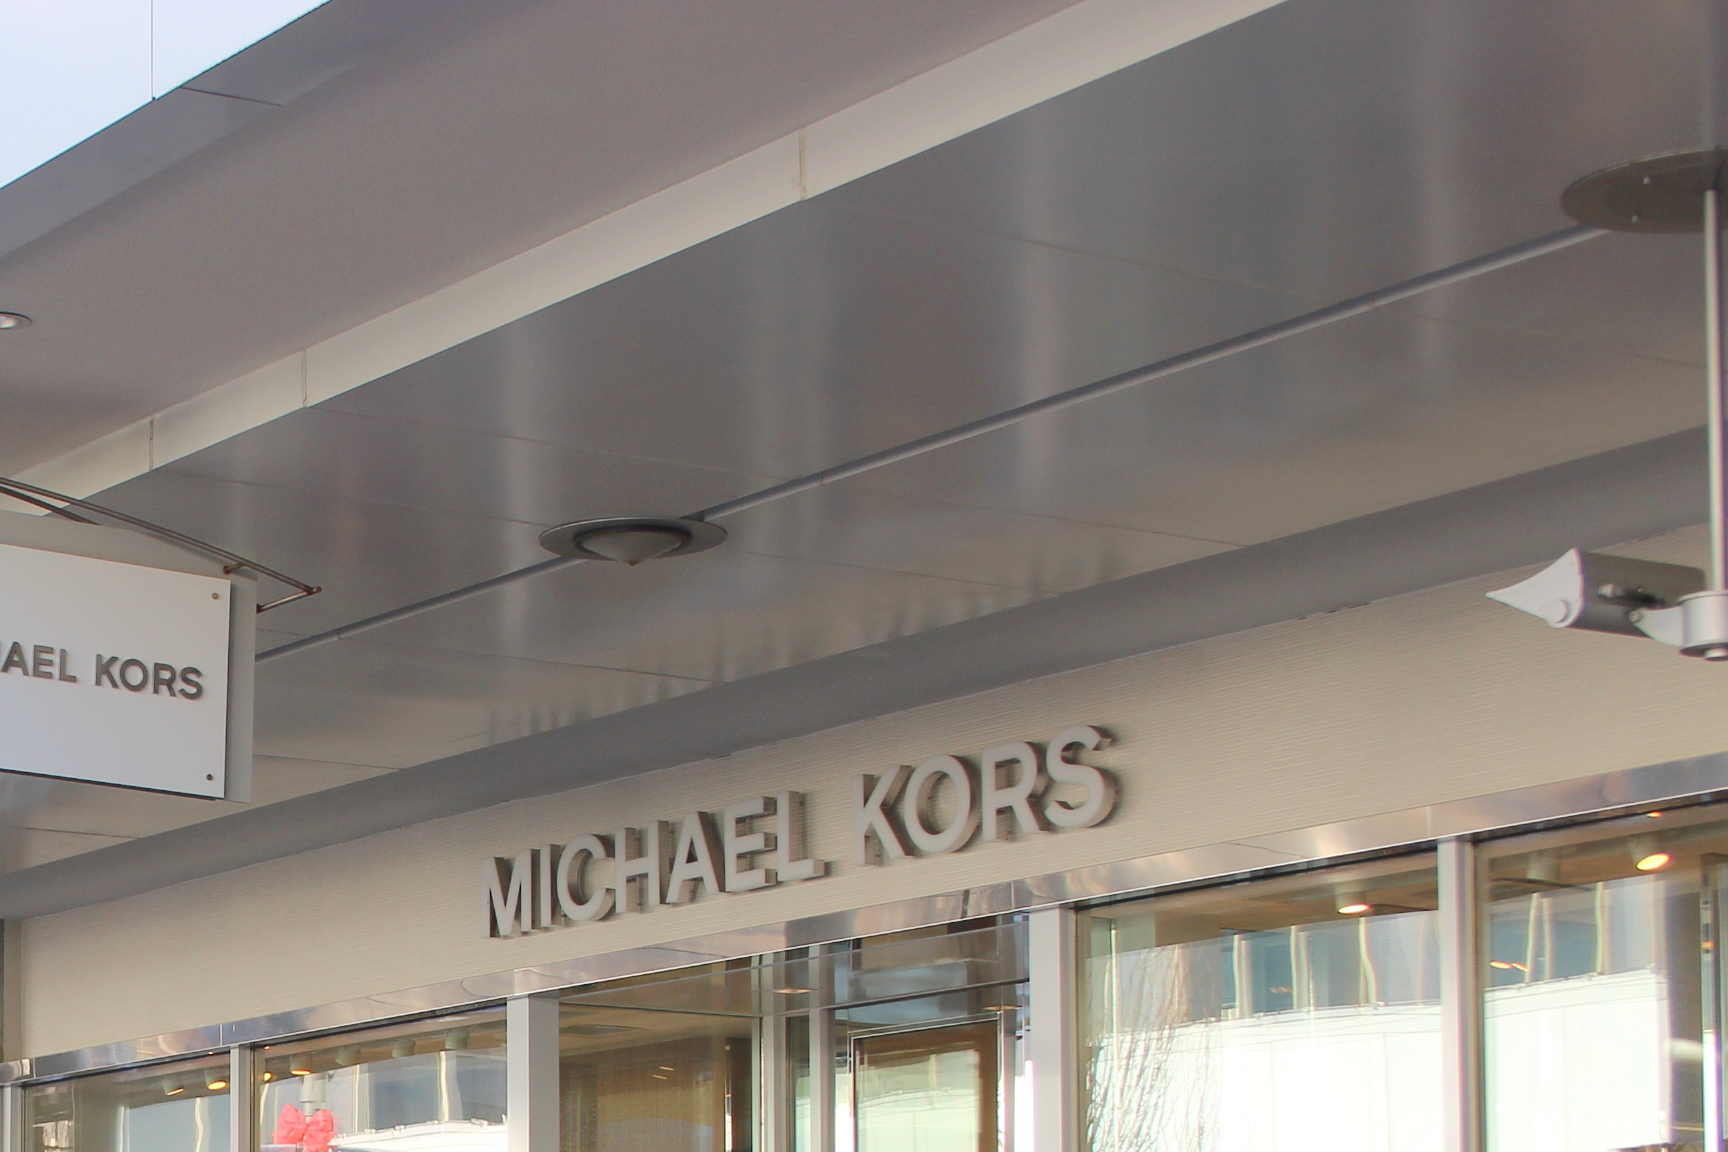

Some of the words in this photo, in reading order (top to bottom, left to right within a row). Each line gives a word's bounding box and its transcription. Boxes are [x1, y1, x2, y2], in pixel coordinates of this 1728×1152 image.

[94, 653, 203, 700] KORS
[481, 790, 826, 939] MICHAEL
[852, 724, 1119, 867] KORS
